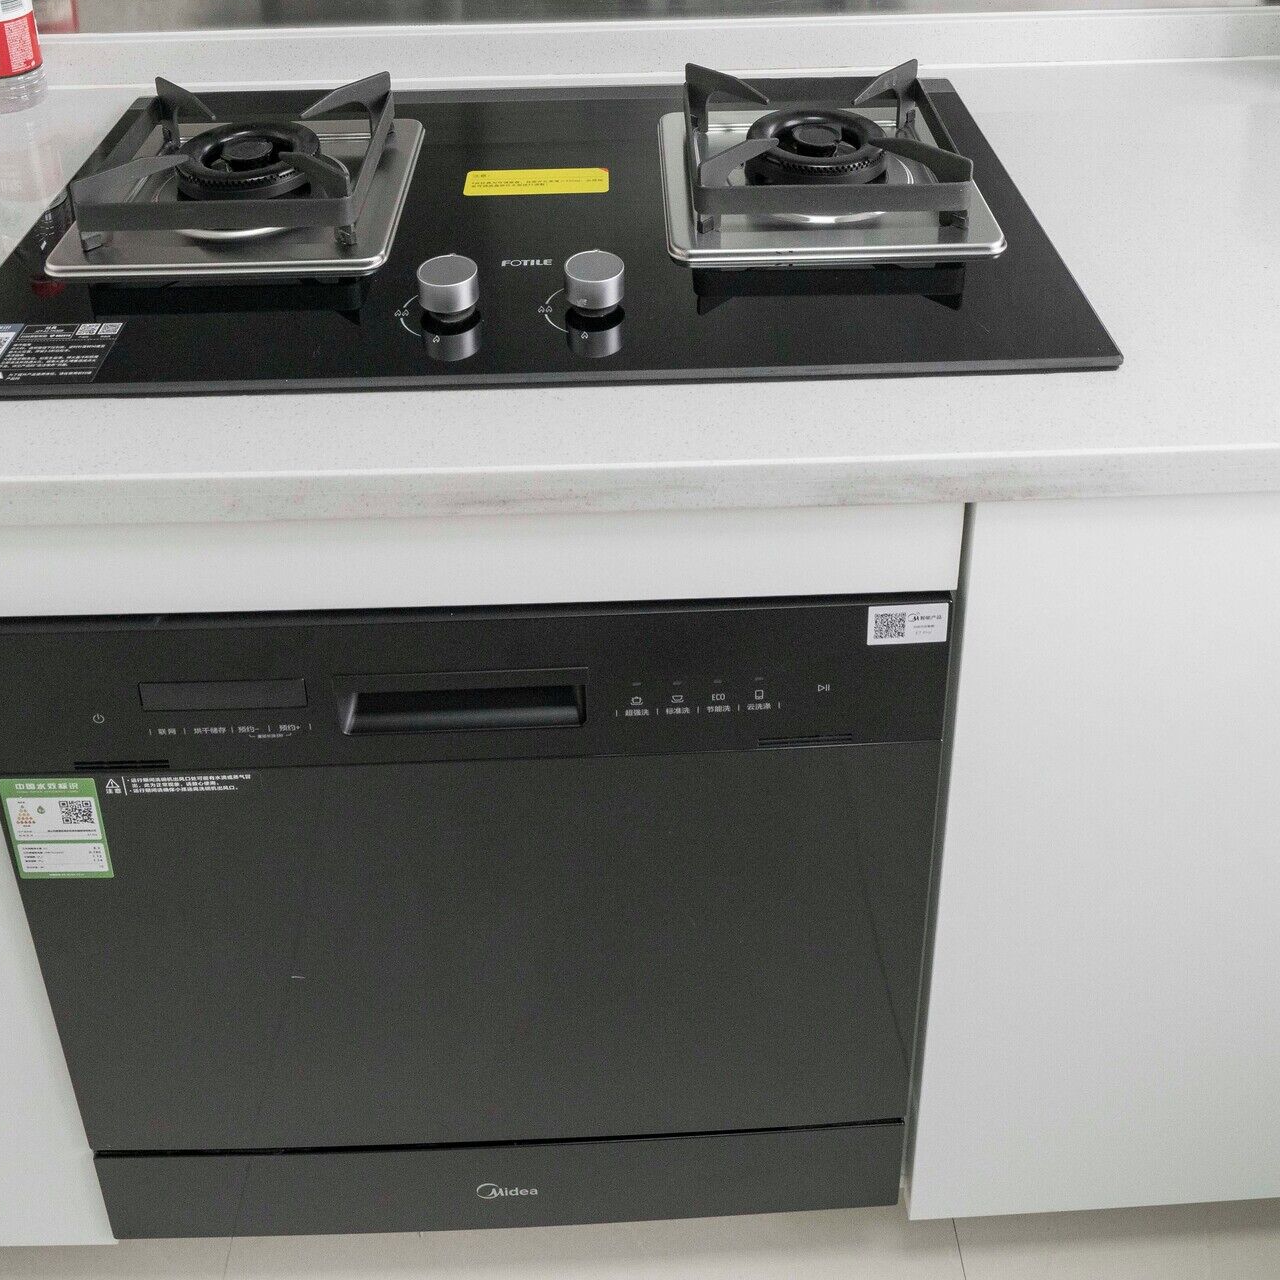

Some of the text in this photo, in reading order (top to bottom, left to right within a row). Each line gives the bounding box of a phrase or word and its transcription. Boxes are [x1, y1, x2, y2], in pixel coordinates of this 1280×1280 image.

[501, 258, 553, 267] FOTILE
[711, 693, 726, 701] ECO
[666, 707, 691, 715] 标准洗
[706, 705, 731, 713] 节能洗
[747, 703, 771, 711] 云洗涤
[477, 1184, 538, 1199] Midea
